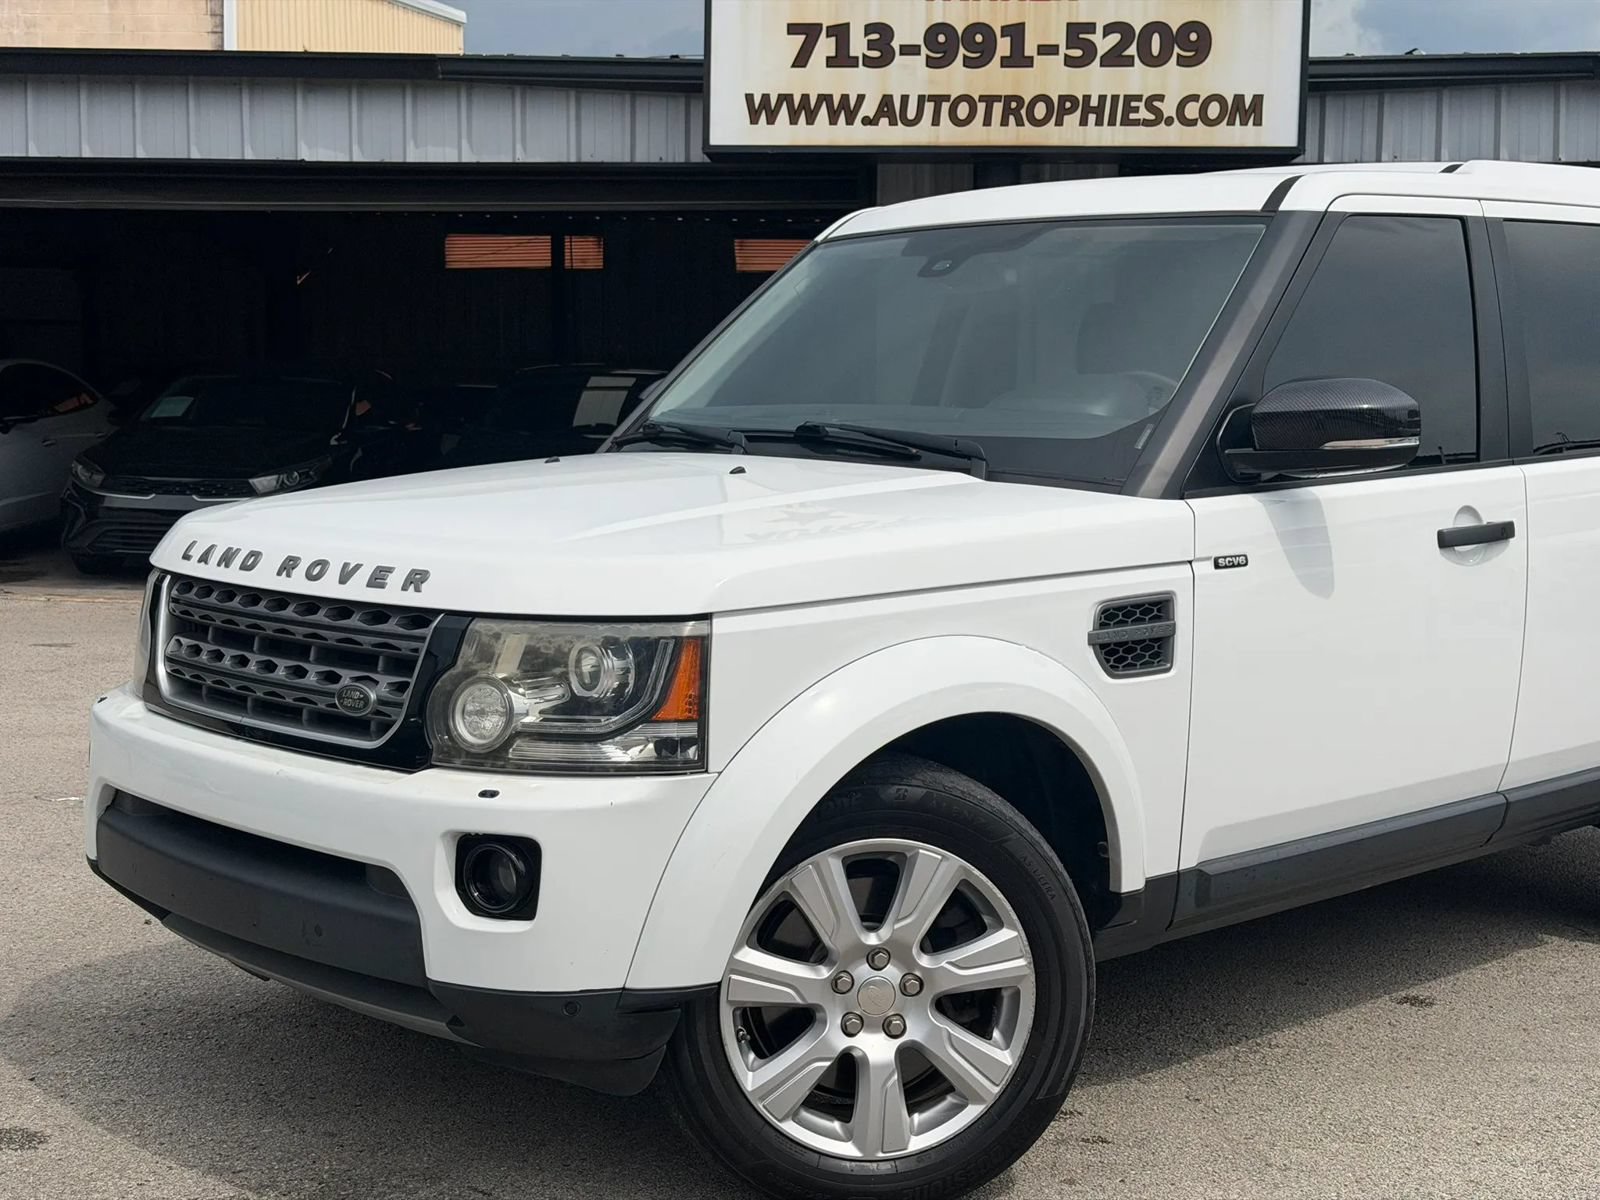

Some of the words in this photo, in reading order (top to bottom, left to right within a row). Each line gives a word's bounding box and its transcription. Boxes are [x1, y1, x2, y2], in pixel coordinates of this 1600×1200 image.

[786, 20, 1213, 69] 713-991-5209
[744, 93, 1264, 128] WWW.AUTOTROPHIES.COM
[181, 540, 262, 571] LAND
[276, 555, 431, 592] ROVER
[1217, 555, 1247, 567] SCV6
[342, 689, 360, 699] LAND
[342, 698, 365, 709] ROVER
